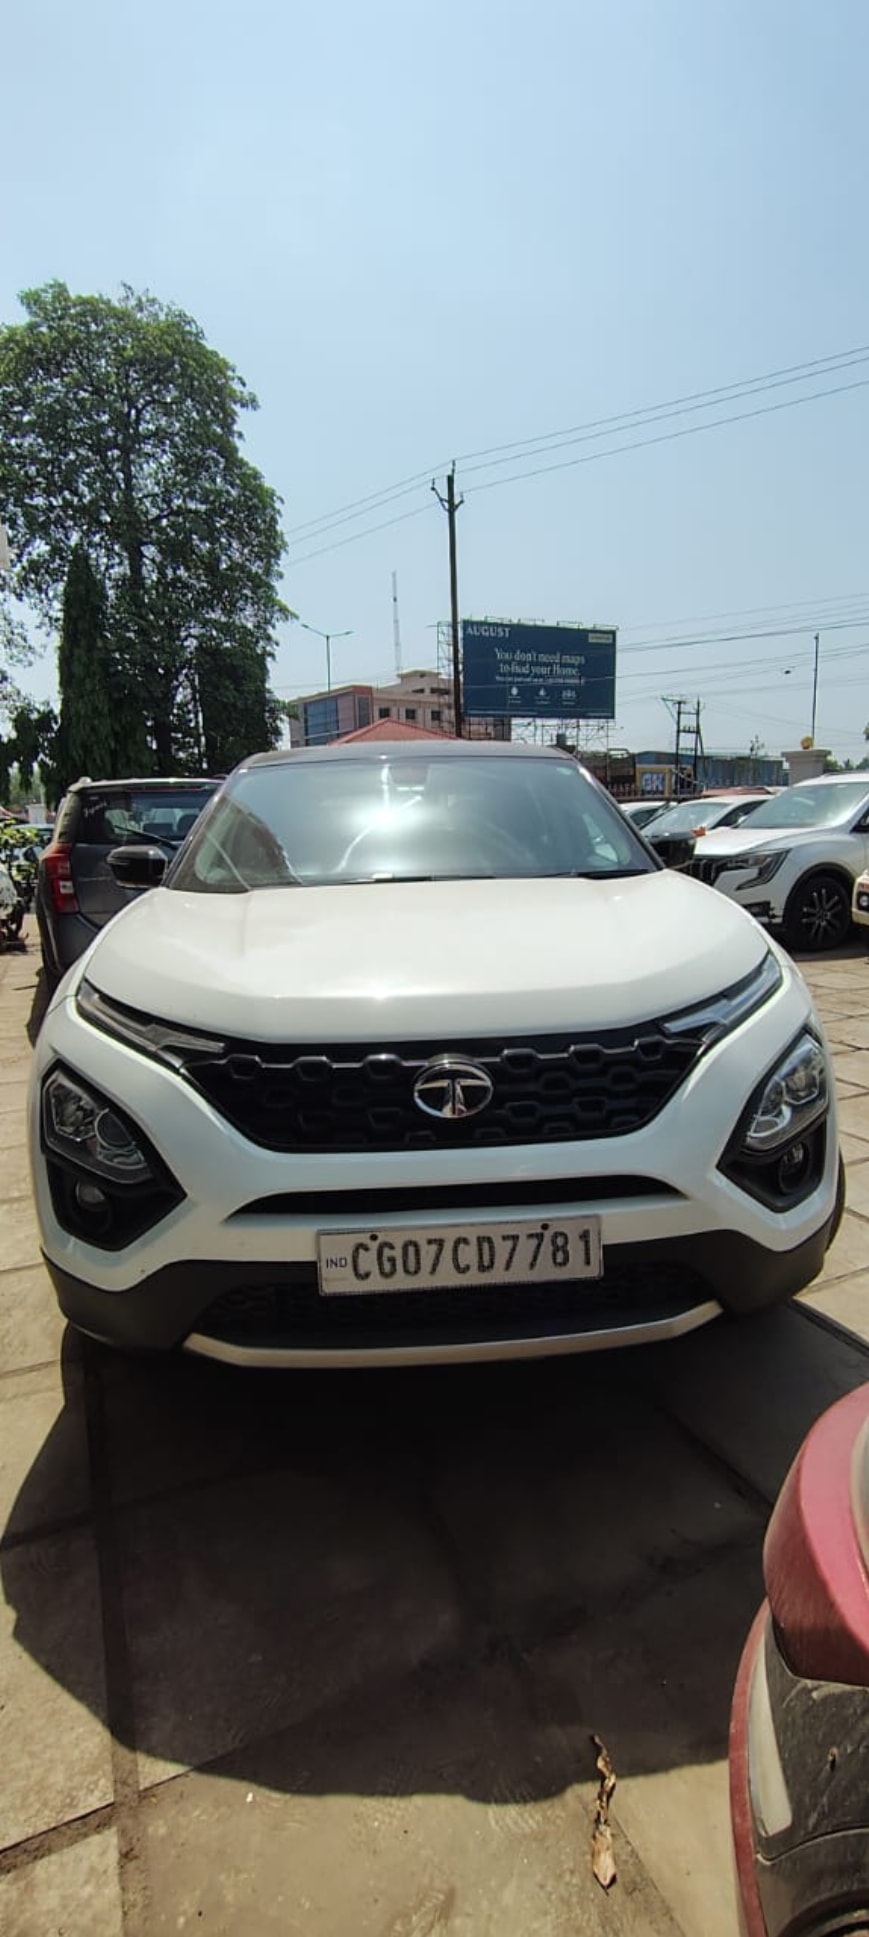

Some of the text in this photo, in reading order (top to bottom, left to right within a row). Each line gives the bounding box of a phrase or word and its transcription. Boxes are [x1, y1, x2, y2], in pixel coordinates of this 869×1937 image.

[466, 624, 511, 638] AUGUST
[495, 648, 585, 666] You don't need maps
[500, 663, 510, 673] to
[531, 665, 551, 677] your
[352, 1228, 592, 1281] CG07CD7781
[326, 1257, 348, 1269] IND
